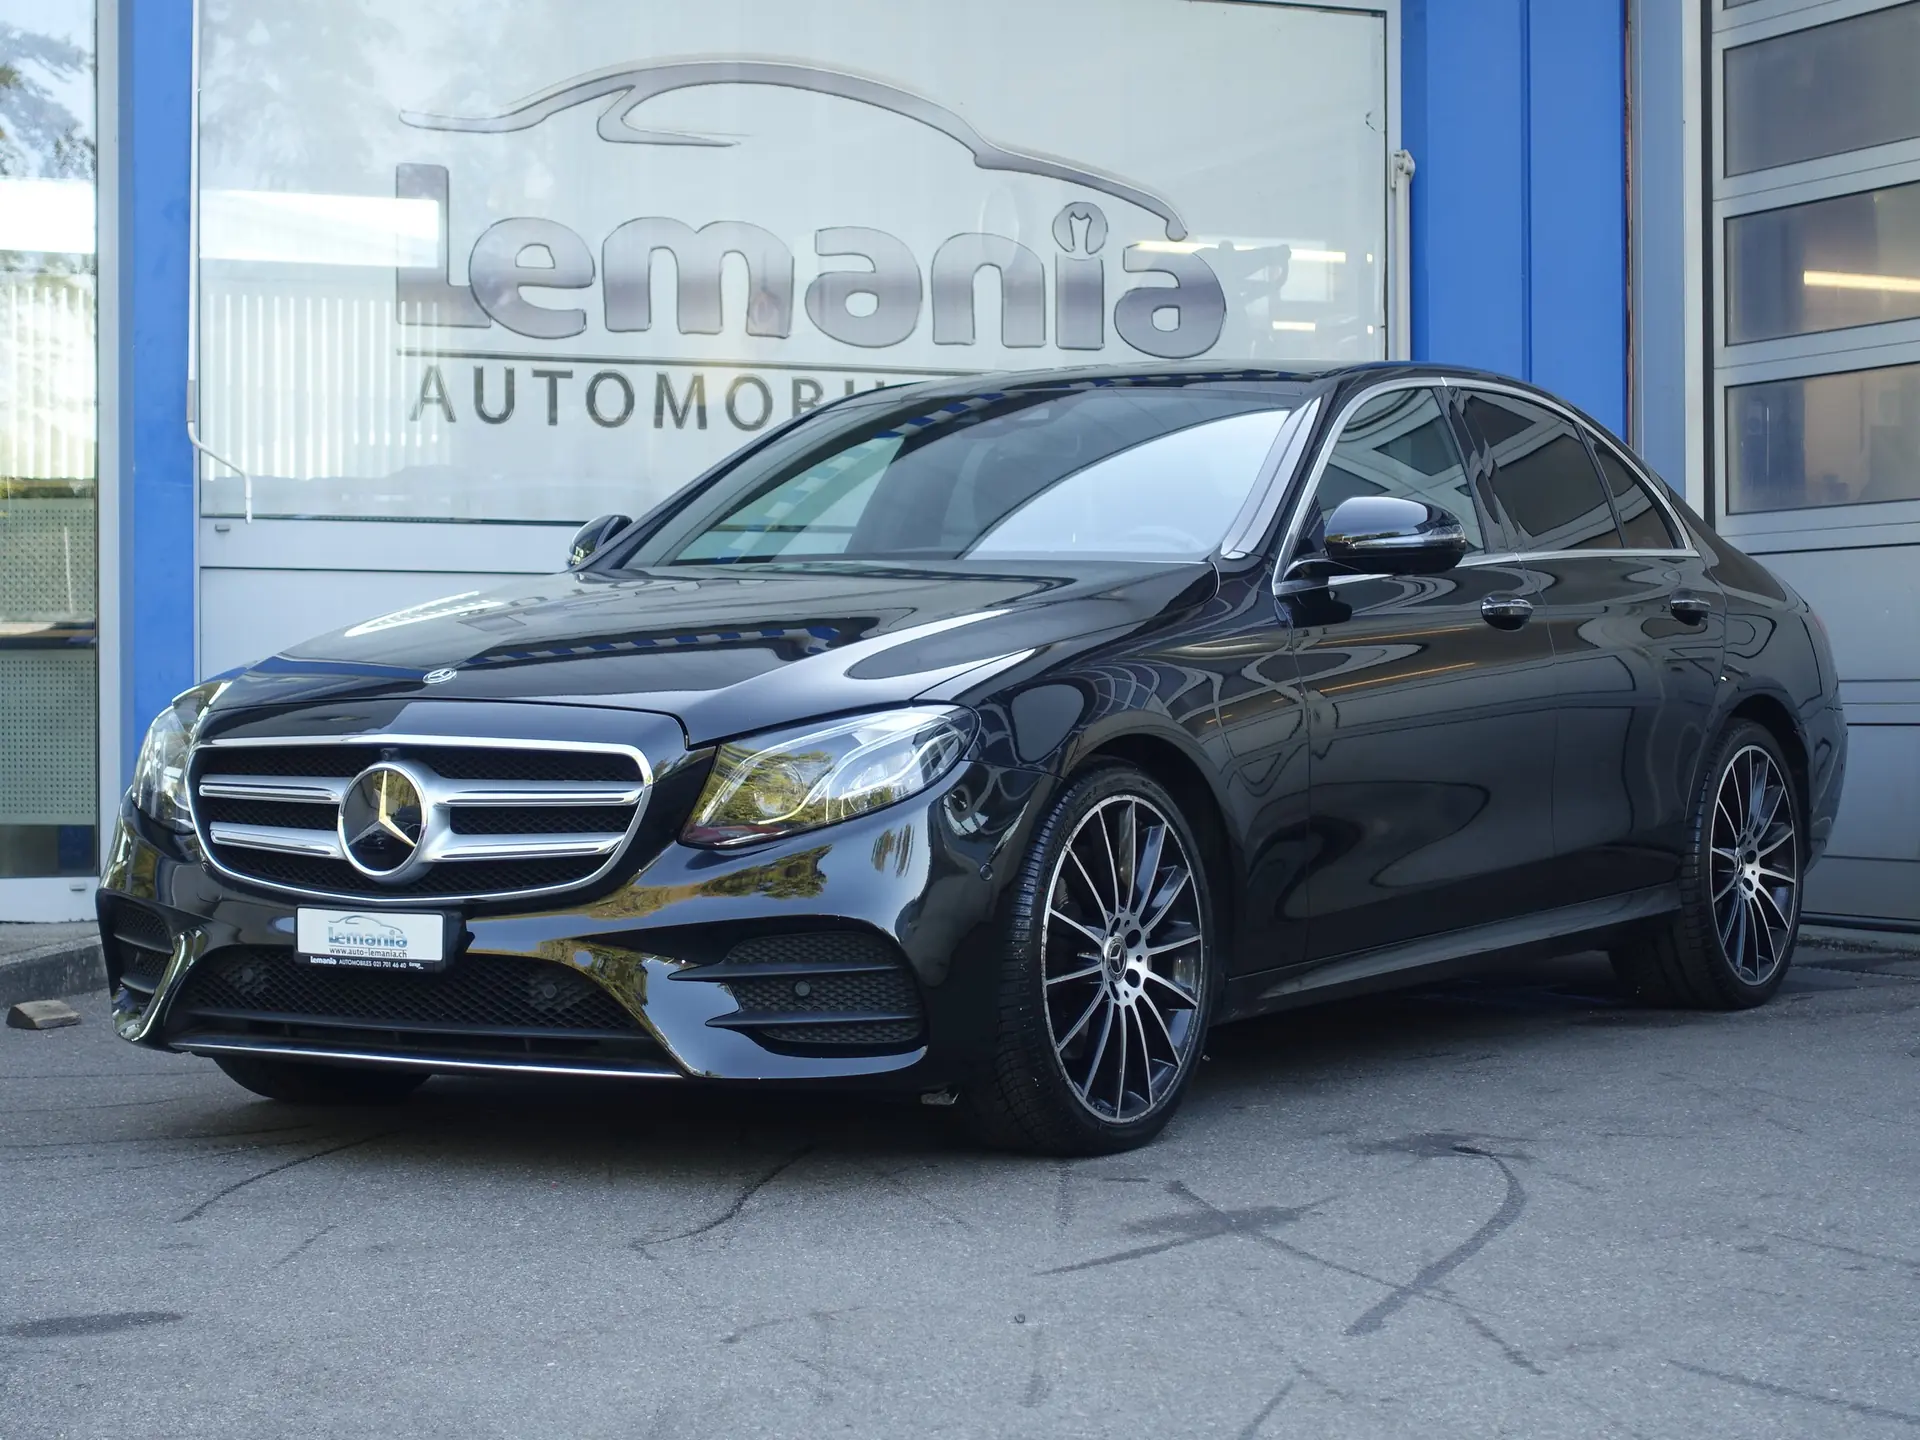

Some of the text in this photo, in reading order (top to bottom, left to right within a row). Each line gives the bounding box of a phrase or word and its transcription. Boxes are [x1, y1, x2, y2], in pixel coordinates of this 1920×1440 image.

[396, 163, 1227, 360] Lemania
[328, 926, 407, 947] Lemania
[329, 947, 407, 958] www.auto-lemania.ch
